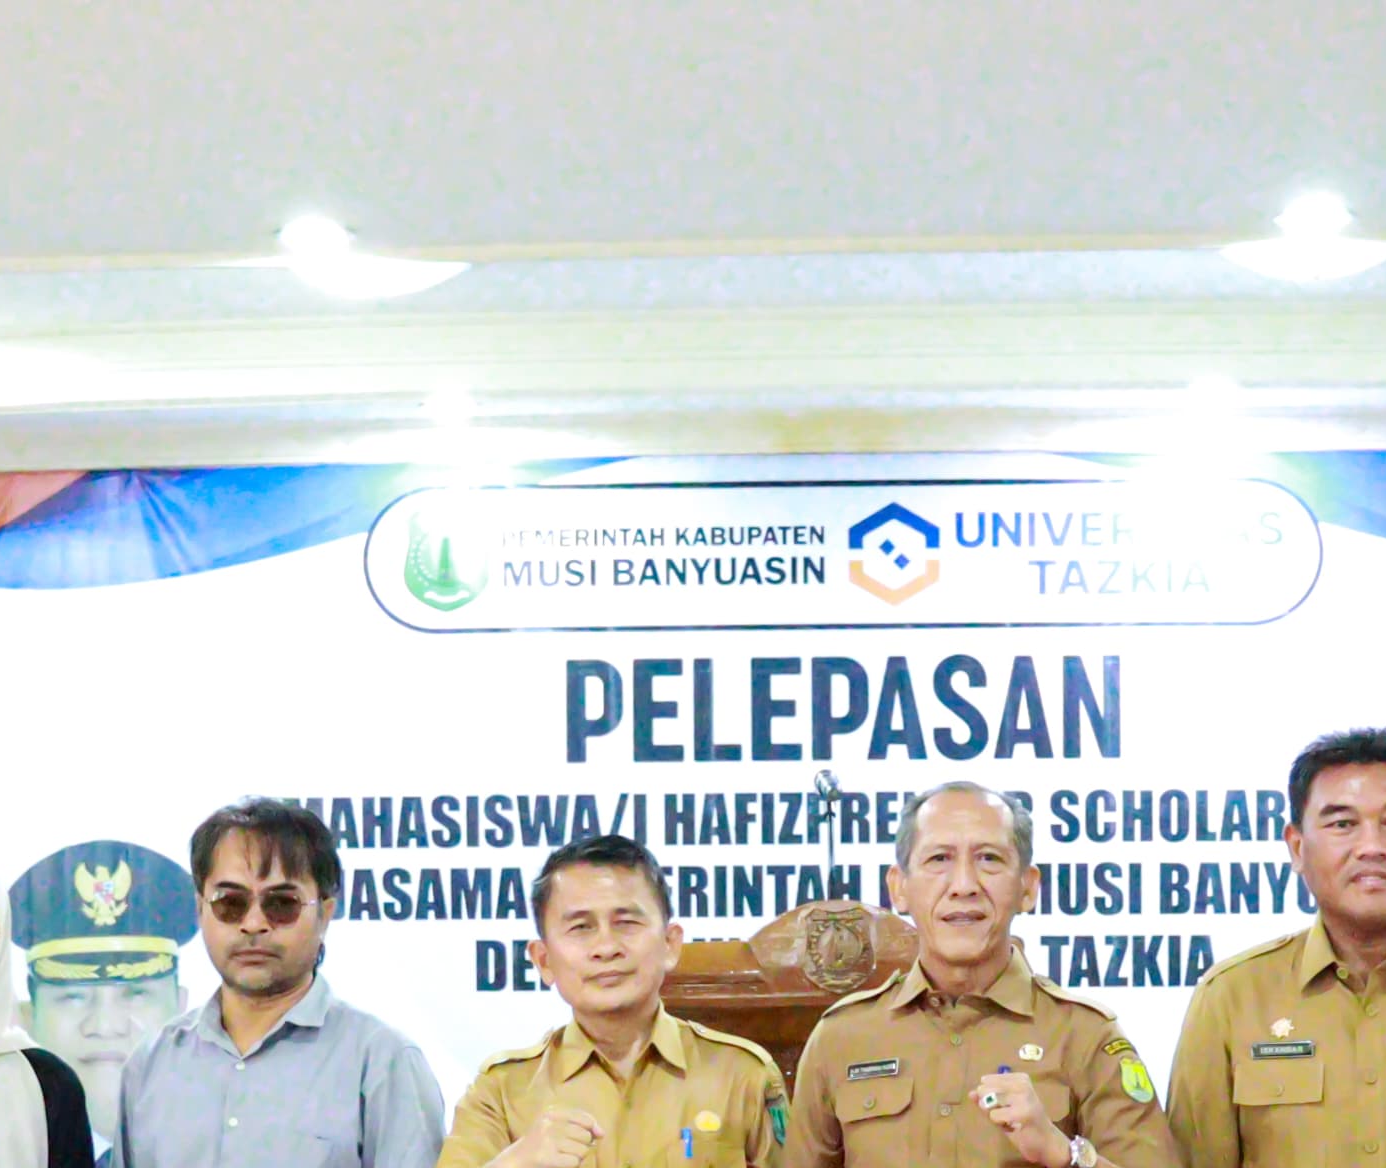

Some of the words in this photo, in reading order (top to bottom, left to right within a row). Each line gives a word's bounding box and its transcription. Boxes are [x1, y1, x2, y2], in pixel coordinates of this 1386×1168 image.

[676, 526, 825, 546] KABUPATEN
[503, 560, 596, 587] MUSI
[612, 556, 826, 586] BANYUASIN
[1028, 560, 1210, 594] TAZKIA
[566, 654, 1121, 763] PELEPASAN
[664, 786, 1033, 845] HAFIZPRE
[1050, 789, 1286, 843] SCHOLAR
[1040, 935, 1215, 988] TAZKIA
